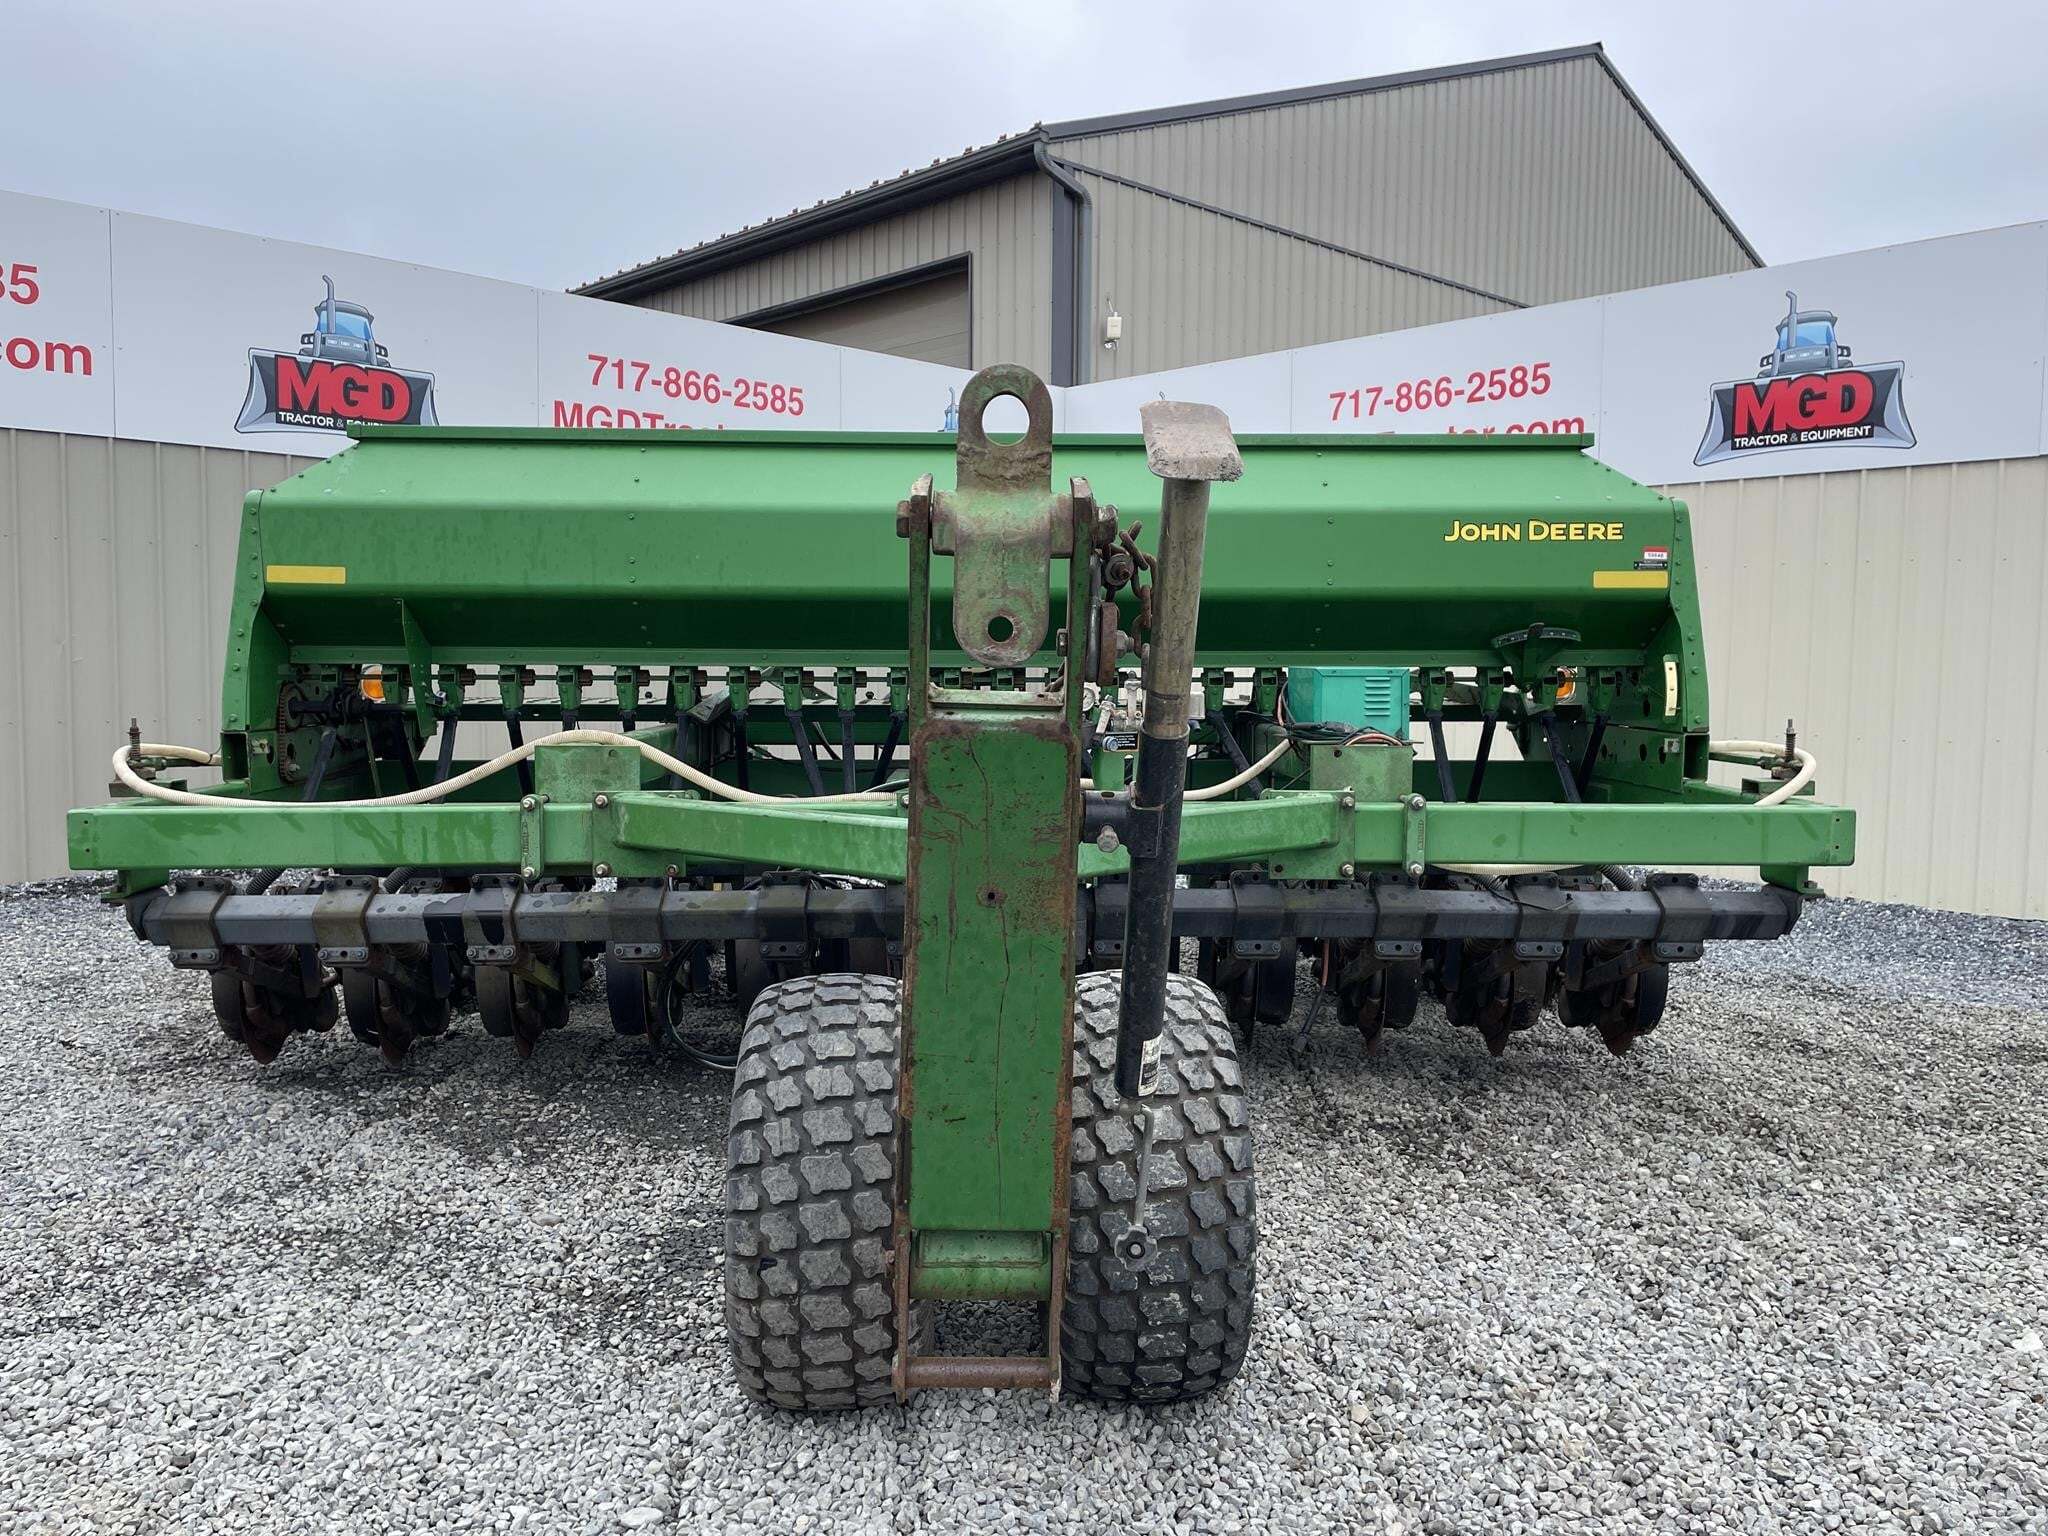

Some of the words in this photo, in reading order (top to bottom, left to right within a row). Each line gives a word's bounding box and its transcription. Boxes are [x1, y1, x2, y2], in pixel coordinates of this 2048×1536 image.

[0, 263, 40, 305] 5
[0, 337, 92, 376] om
[275, 355, 412, 422] MGD
[588, 354, 804, 417] 717-866-2585
[1329, 362, 1551, 421] 717-866-2585
[1733, 370, 1874, 436] MGD
[278, 411, 335, 427] TRACTOR
[336, 419, 345, 428] &
[1734, 433, 1788, 449] TRACTOR
[1789, 431, 1799, 443] &
[1800, 424, 1872, 443] EQUIPMENT
[1444, 520, 1521, 542] JOHN
[1528, 519, 1624, 541] DEERE
